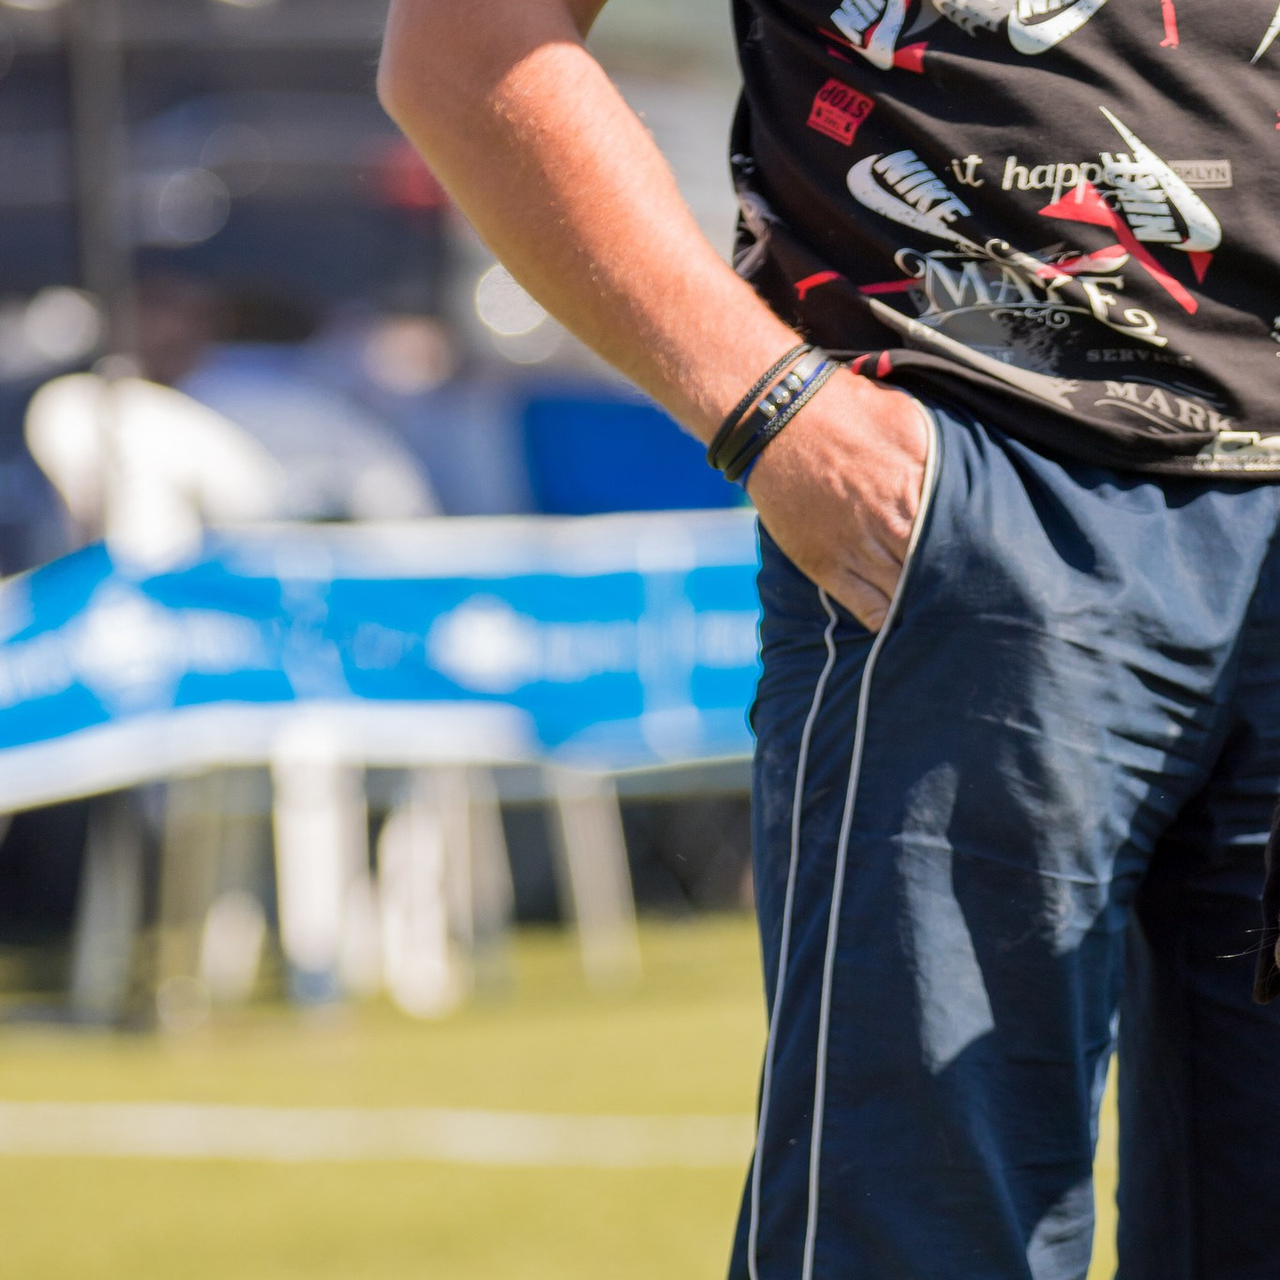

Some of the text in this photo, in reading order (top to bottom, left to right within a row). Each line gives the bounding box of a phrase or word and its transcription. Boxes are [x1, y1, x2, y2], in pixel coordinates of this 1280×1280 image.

[874, 149, 972, 224] NIKE
[951, 154, 985, 188] it
[1103, 380, 1234, 432] MARK
